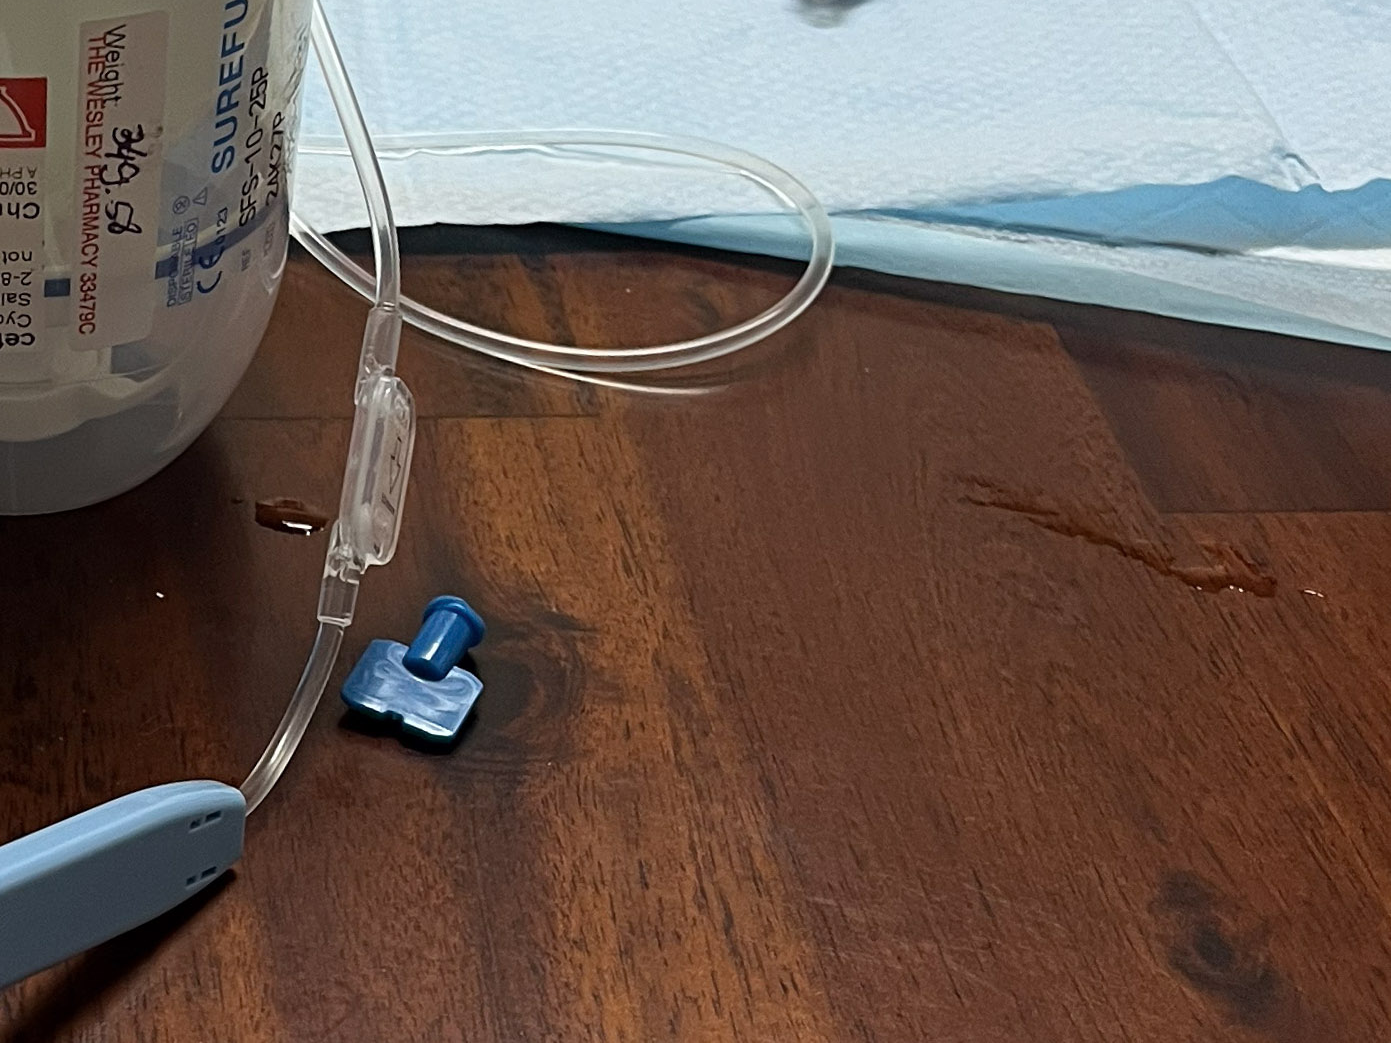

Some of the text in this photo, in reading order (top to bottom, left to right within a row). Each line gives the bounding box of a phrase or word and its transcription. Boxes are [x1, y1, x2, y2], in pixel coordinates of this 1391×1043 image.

[78, 34, 107, 335] THE WESLEY PHARMACY 33479C
[239, 66, 269, 228] SFS-10-25P
[2, 250, 33, 265] not
